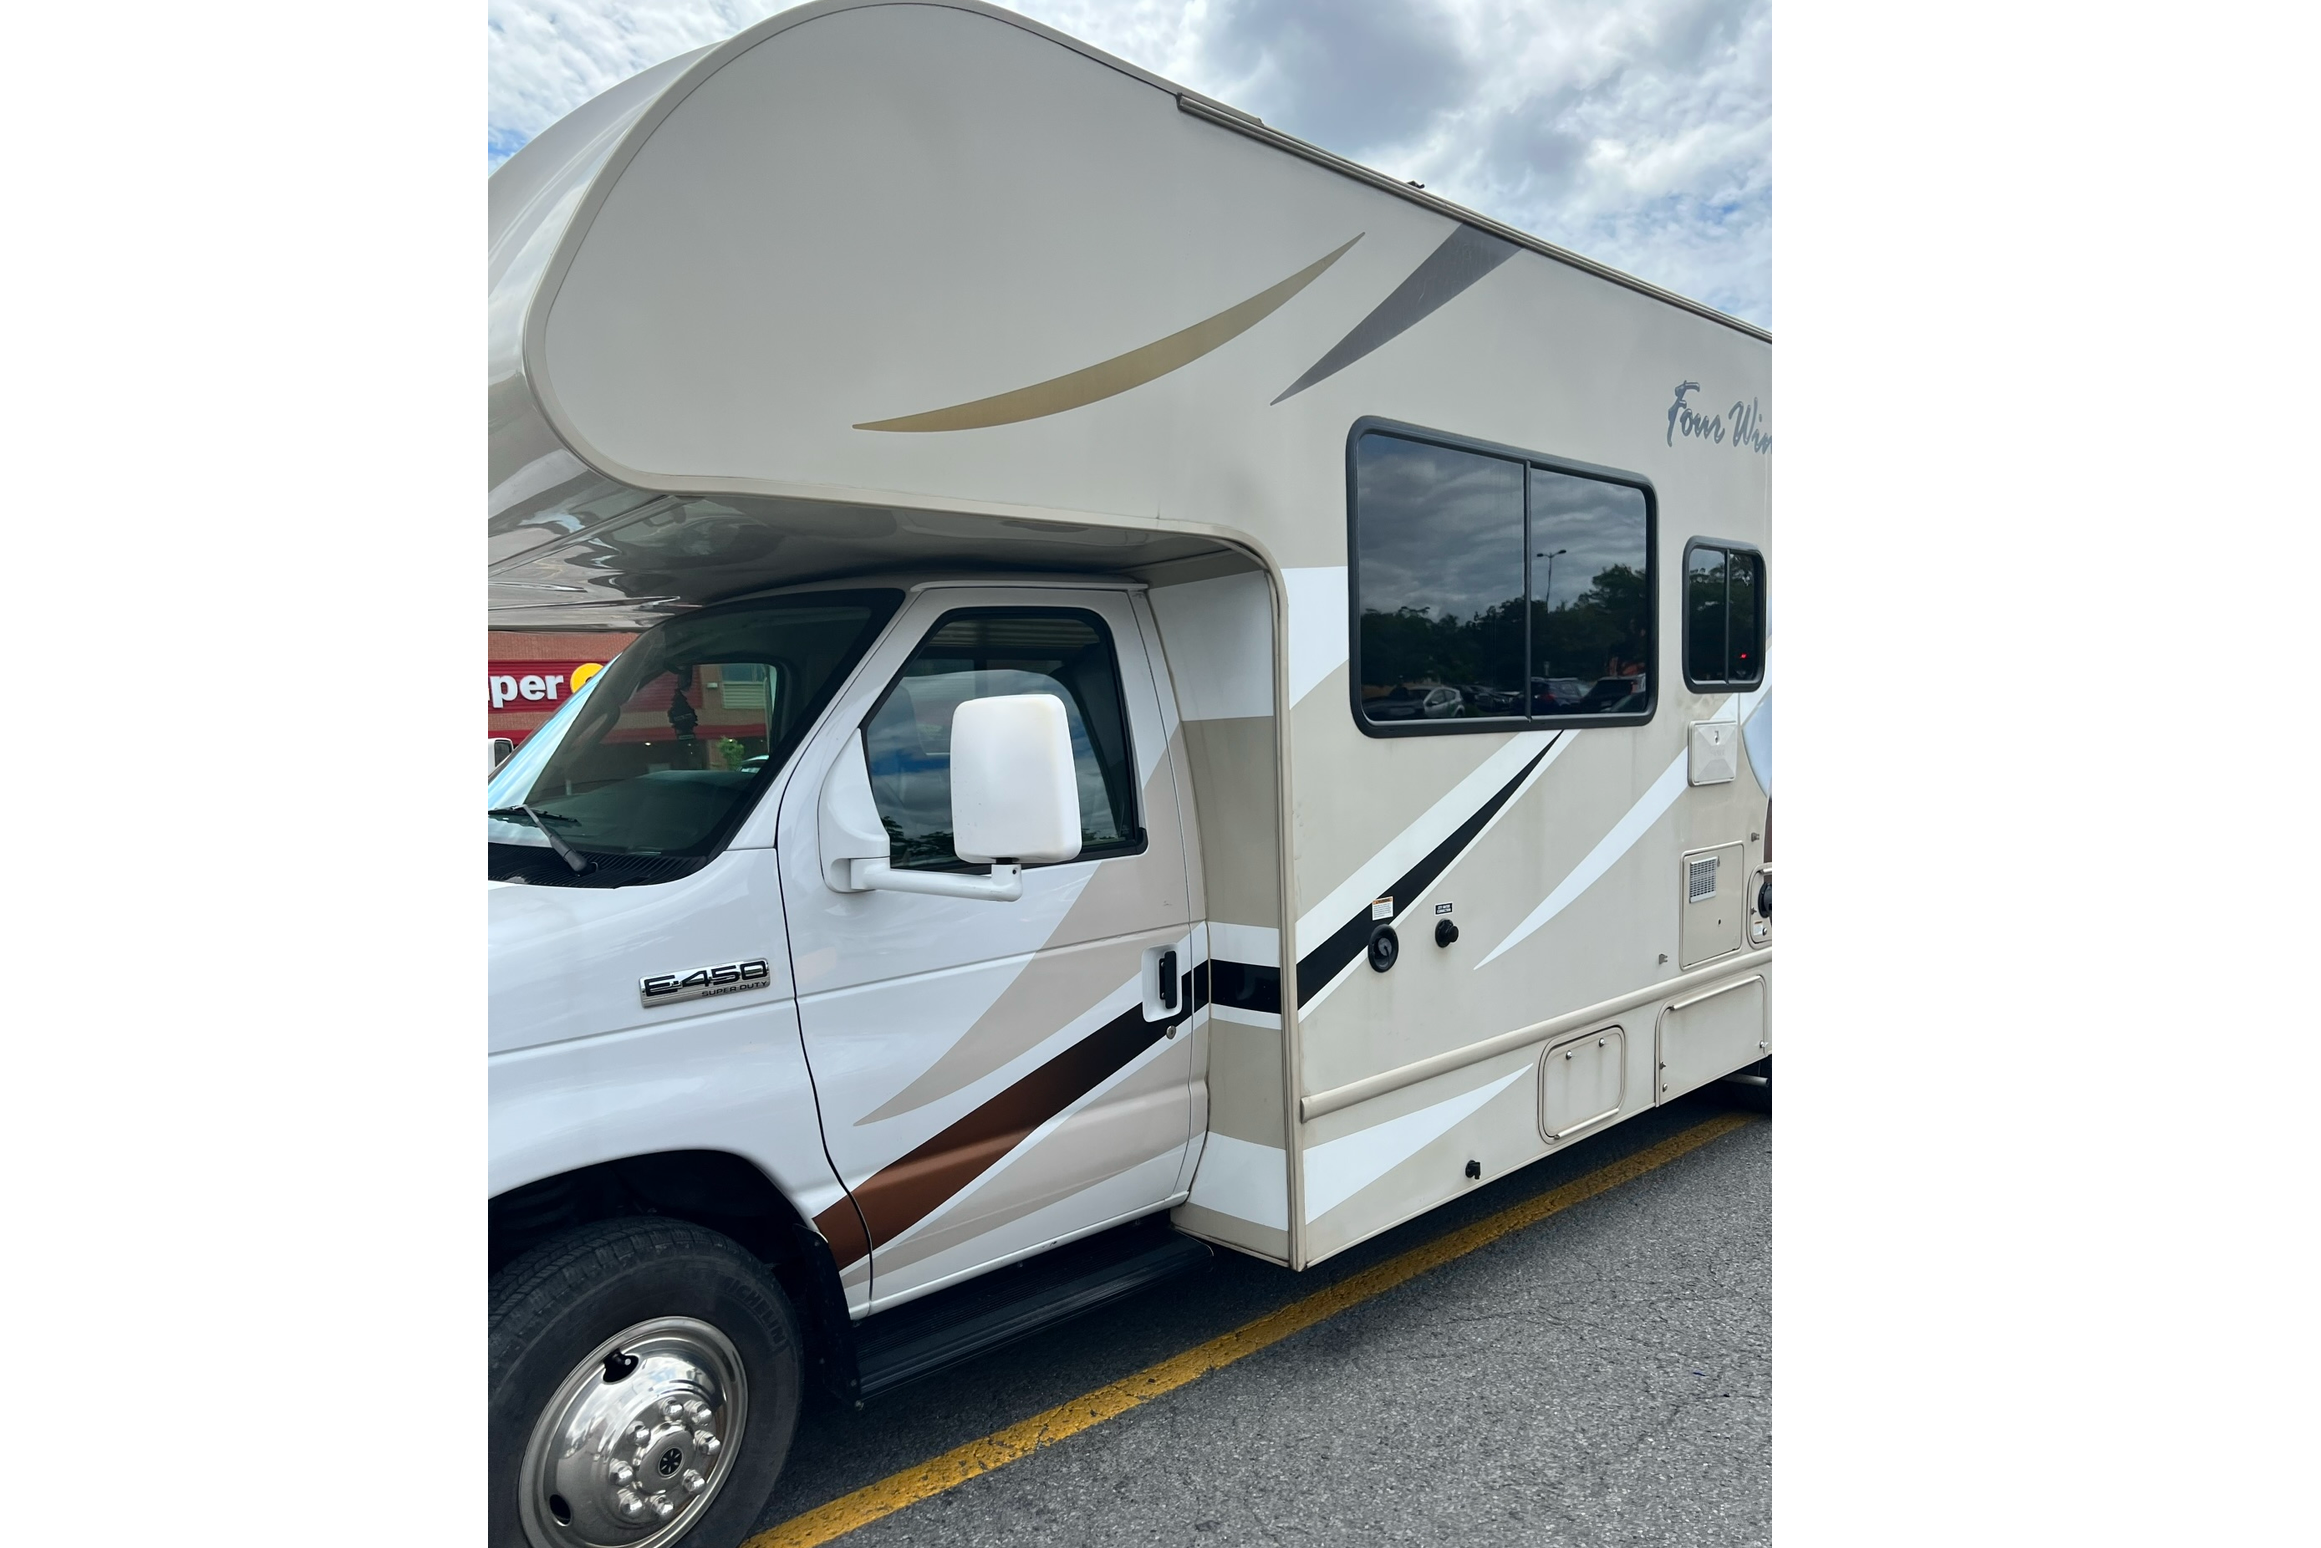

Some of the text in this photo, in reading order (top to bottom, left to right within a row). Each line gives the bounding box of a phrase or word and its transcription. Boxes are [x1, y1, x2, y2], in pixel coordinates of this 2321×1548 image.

[1667, 380, 1725, 447] Four
[488, 675, 564, 708] per
[701, 981, 768, 997] SUPER DUTY
